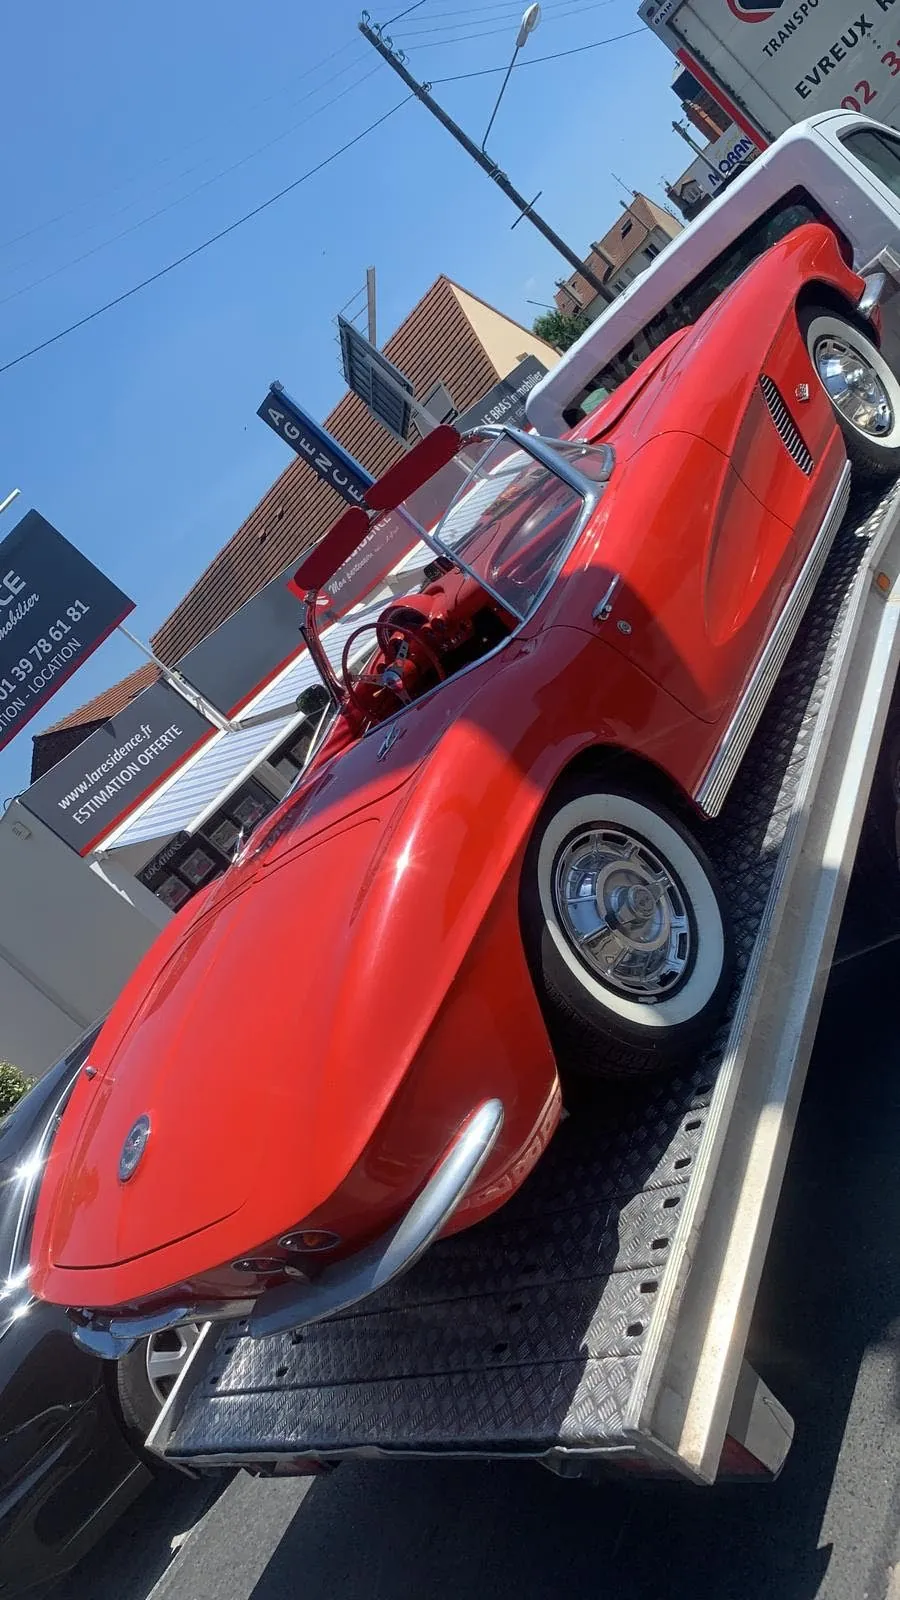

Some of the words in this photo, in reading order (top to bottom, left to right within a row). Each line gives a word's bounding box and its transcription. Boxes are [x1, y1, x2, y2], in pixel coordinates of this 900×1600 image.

[795, 13, 874, 99] EVREUX
[841, 80, 878, 112] 02
[881, 39, 900, 76] 3
[490, 398, 512, 420] BRAS
[268, 407, 363, 502] AGENCE
[0, 570, 27, 613] CE
[0, 678, 17, 701] 01
[11, 658, 34, 682] 39
[28, 638, 53, 662] 78
[49, 619, 72, 642] 61
[66, 600, 91, 623] 81
[28, 637, 83, 695] LOCATION
[57, 723, 154, 810] www.laresidence.fr
[72, 762, 142, 825] ESTIMATION
[137, 724, 184, 766] OFFERTE
